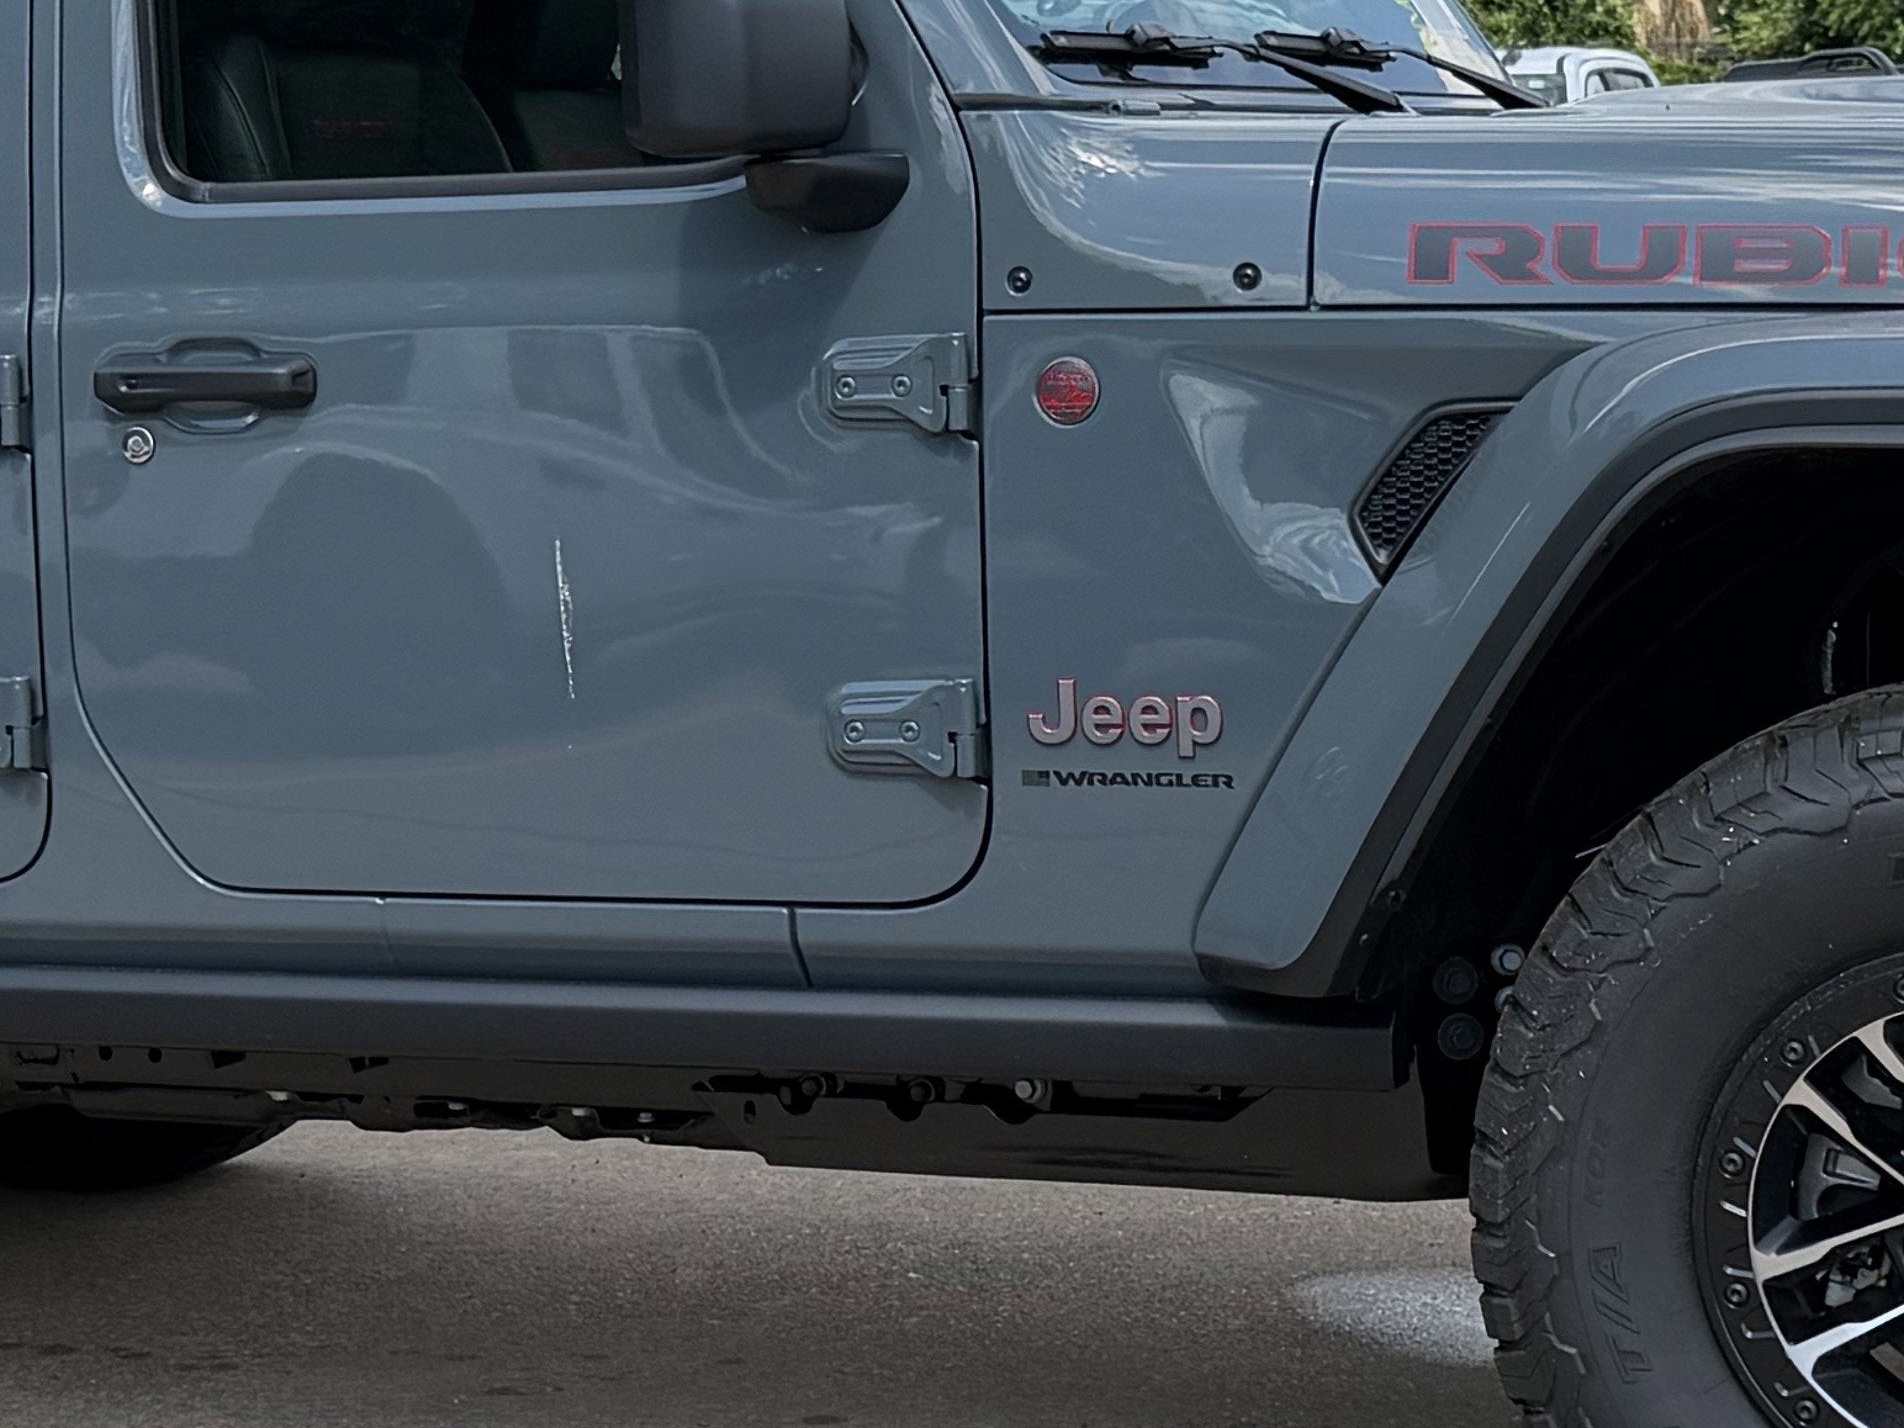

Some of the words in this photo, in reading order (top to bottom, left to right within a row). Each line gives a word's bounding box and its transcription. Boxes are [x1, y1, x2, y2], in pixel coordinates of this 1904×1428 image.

[1027, 677, 1224, 760] Jeep
[1053, 770, 1236, 790] WRANGLER
[1601, 1241, 1657, 1386] T/A
